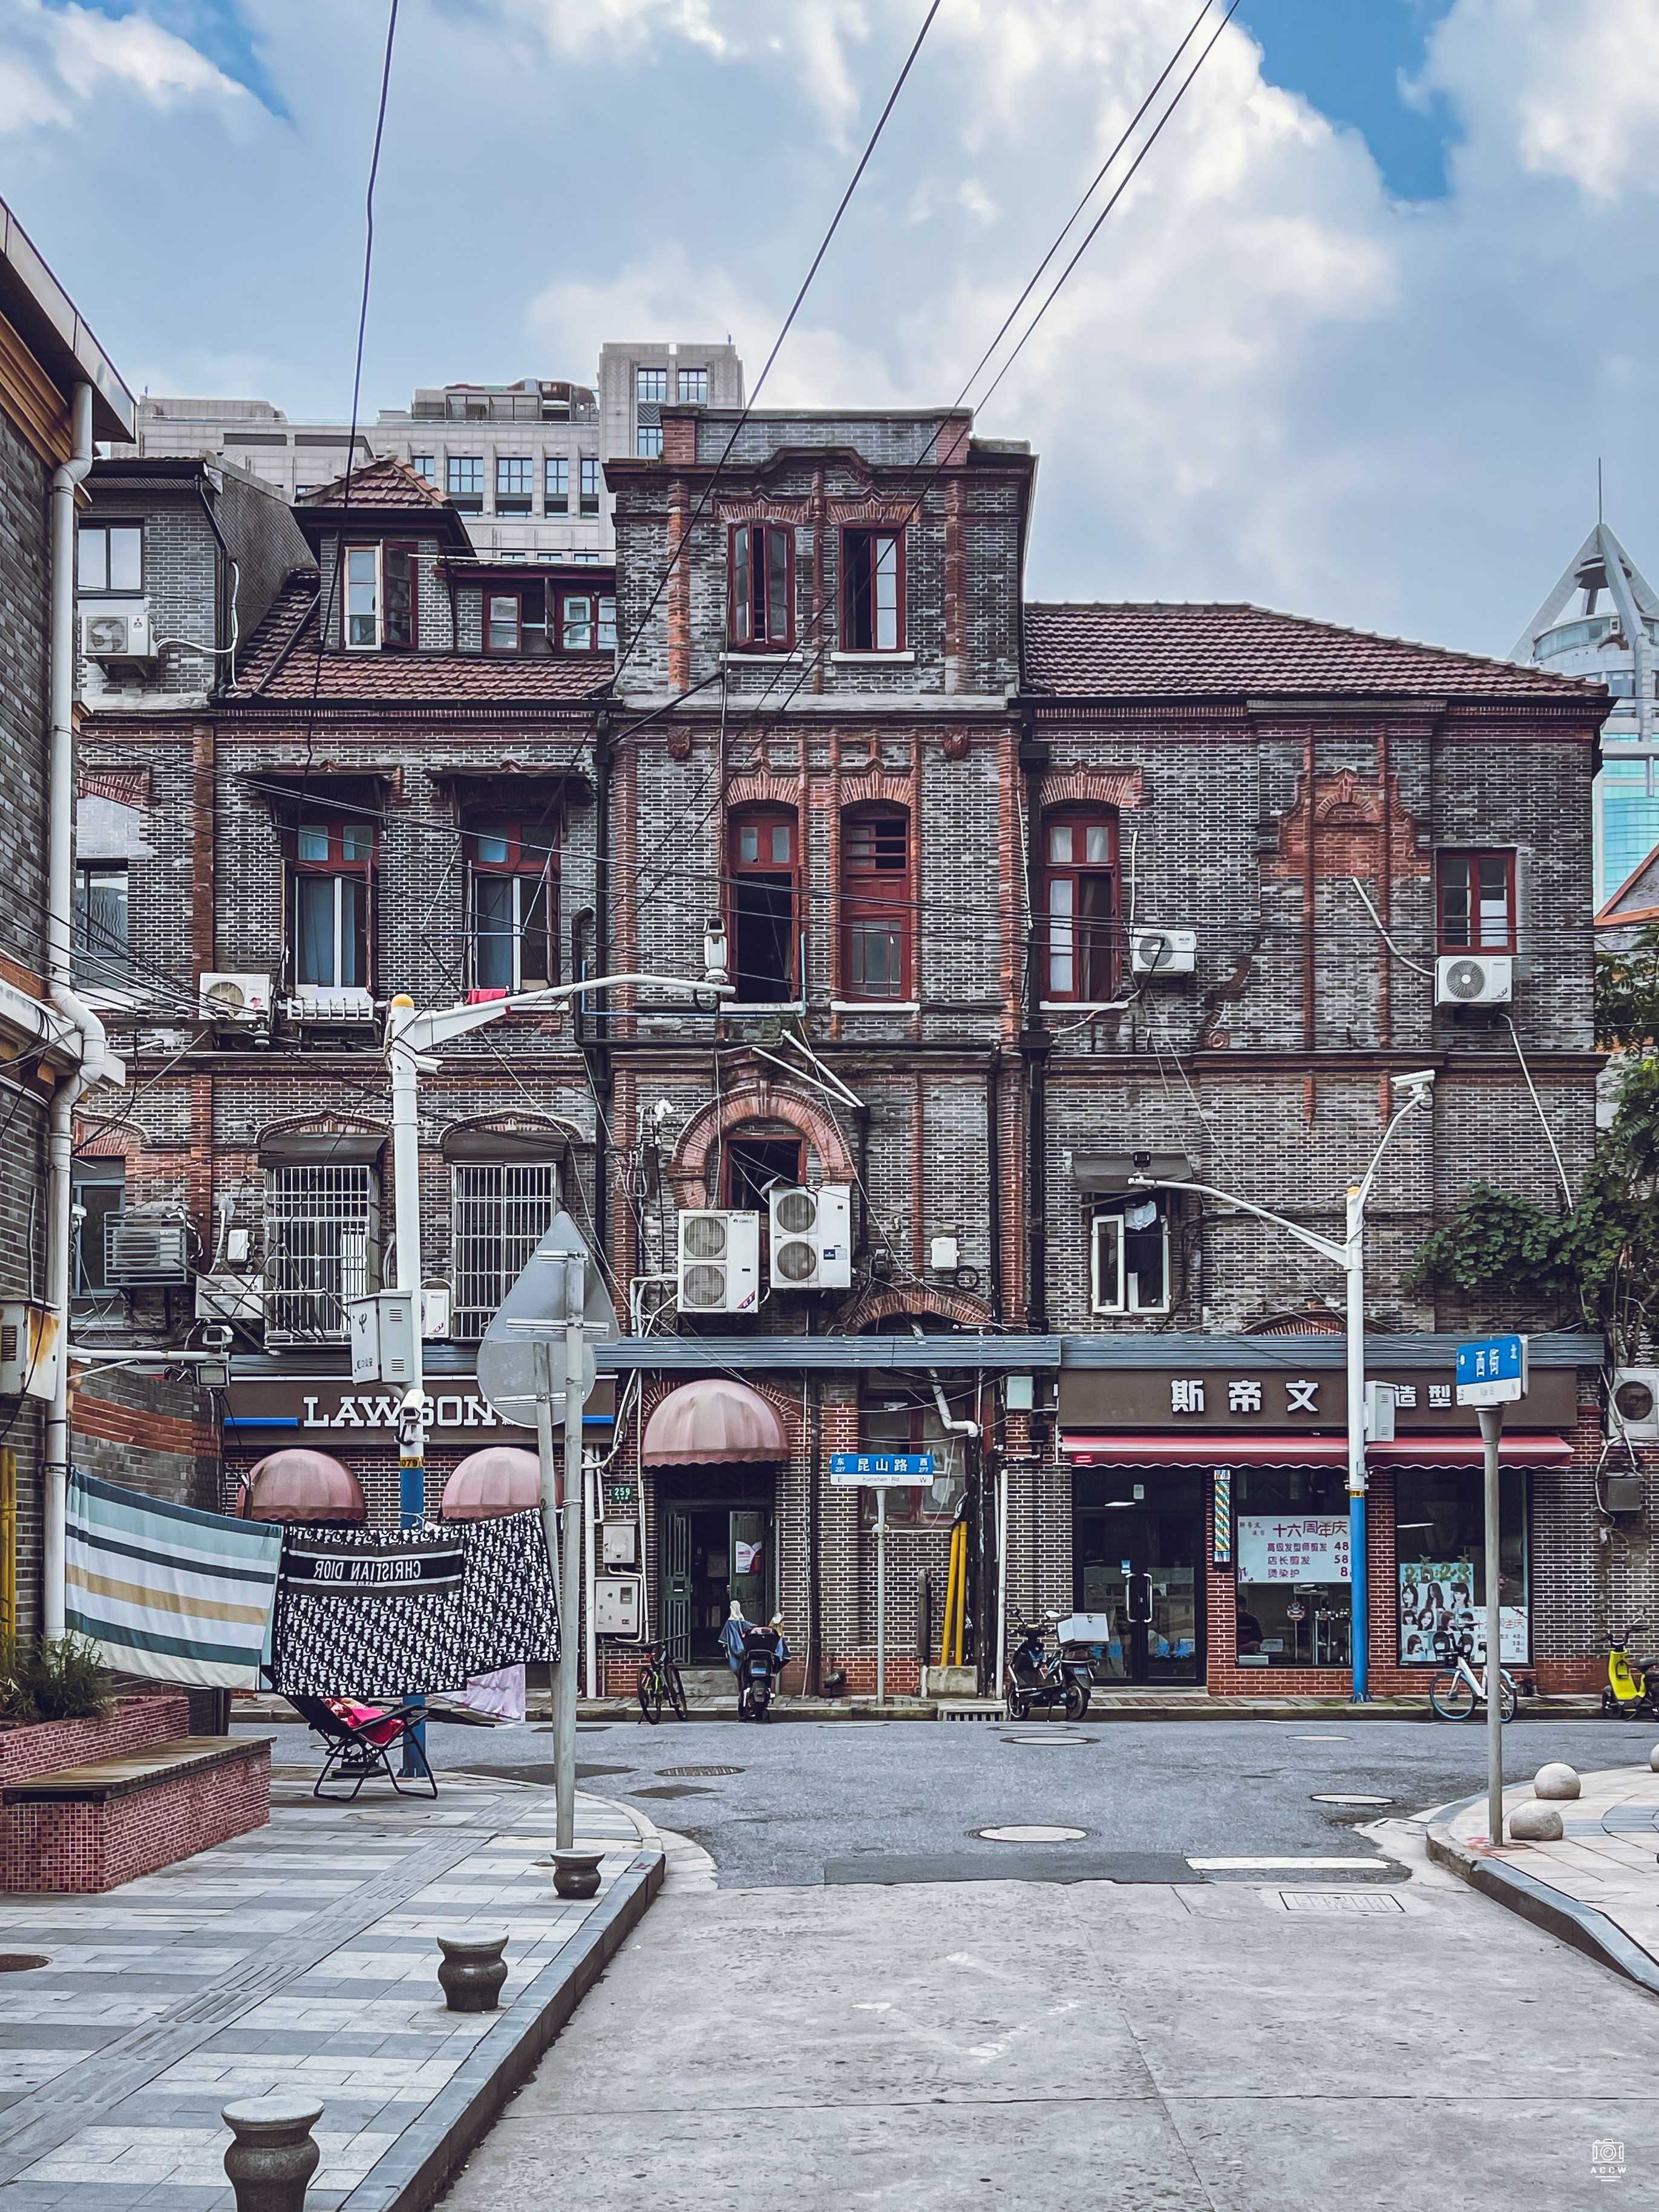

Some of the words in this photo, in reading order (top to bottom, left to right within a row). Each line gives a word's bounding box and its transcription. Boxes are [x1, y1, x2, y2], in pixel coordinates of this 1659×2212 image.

[1171, 1380, 1318, 1412] 斯帝文
[1394, 1384, 1452, 1407] 造型
[837, 1458, 845, 1466] 东
[858, 1458, 908, 1471] 昆山路
[920, 1458, 928, 1466] 西
[614, 1487, 630, 1496] 259
[1273, 1520, 1348, 1537] 十六周年庆
[1334, 1542, 1349, 1550] 48
[1333, 1555, 1349, 1564] 58
